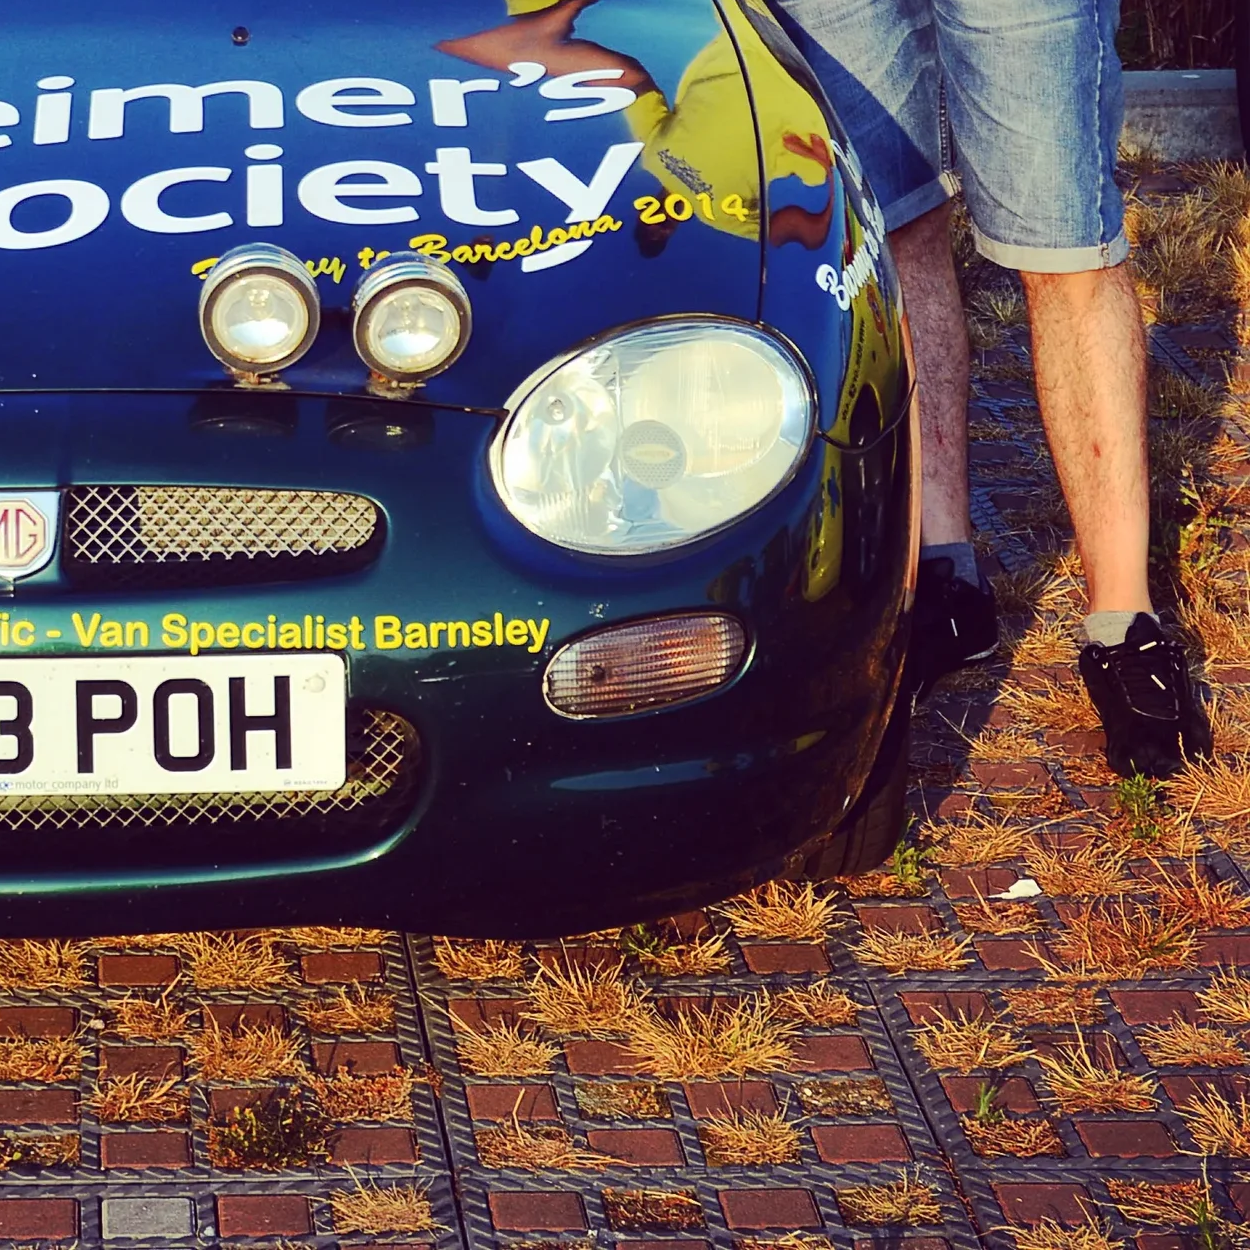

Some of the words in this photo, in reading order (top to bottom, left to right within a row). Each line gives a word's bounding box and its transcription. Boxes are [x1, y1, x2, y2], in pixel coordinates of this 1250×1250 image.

[409, 214, 623, 264] Barcelona
[633, 193, 750, 225] 2014
[72, 612, 149, 647] Van
[162, 613, 366, 655] Specialist
[375, 612, 550, 654] Barnsley
[75, 674, 293, 774] POH
[15, 780, 47, 790] motor
[51, 780, 101, 792] company
[104, 778, 119, 789] ltd
